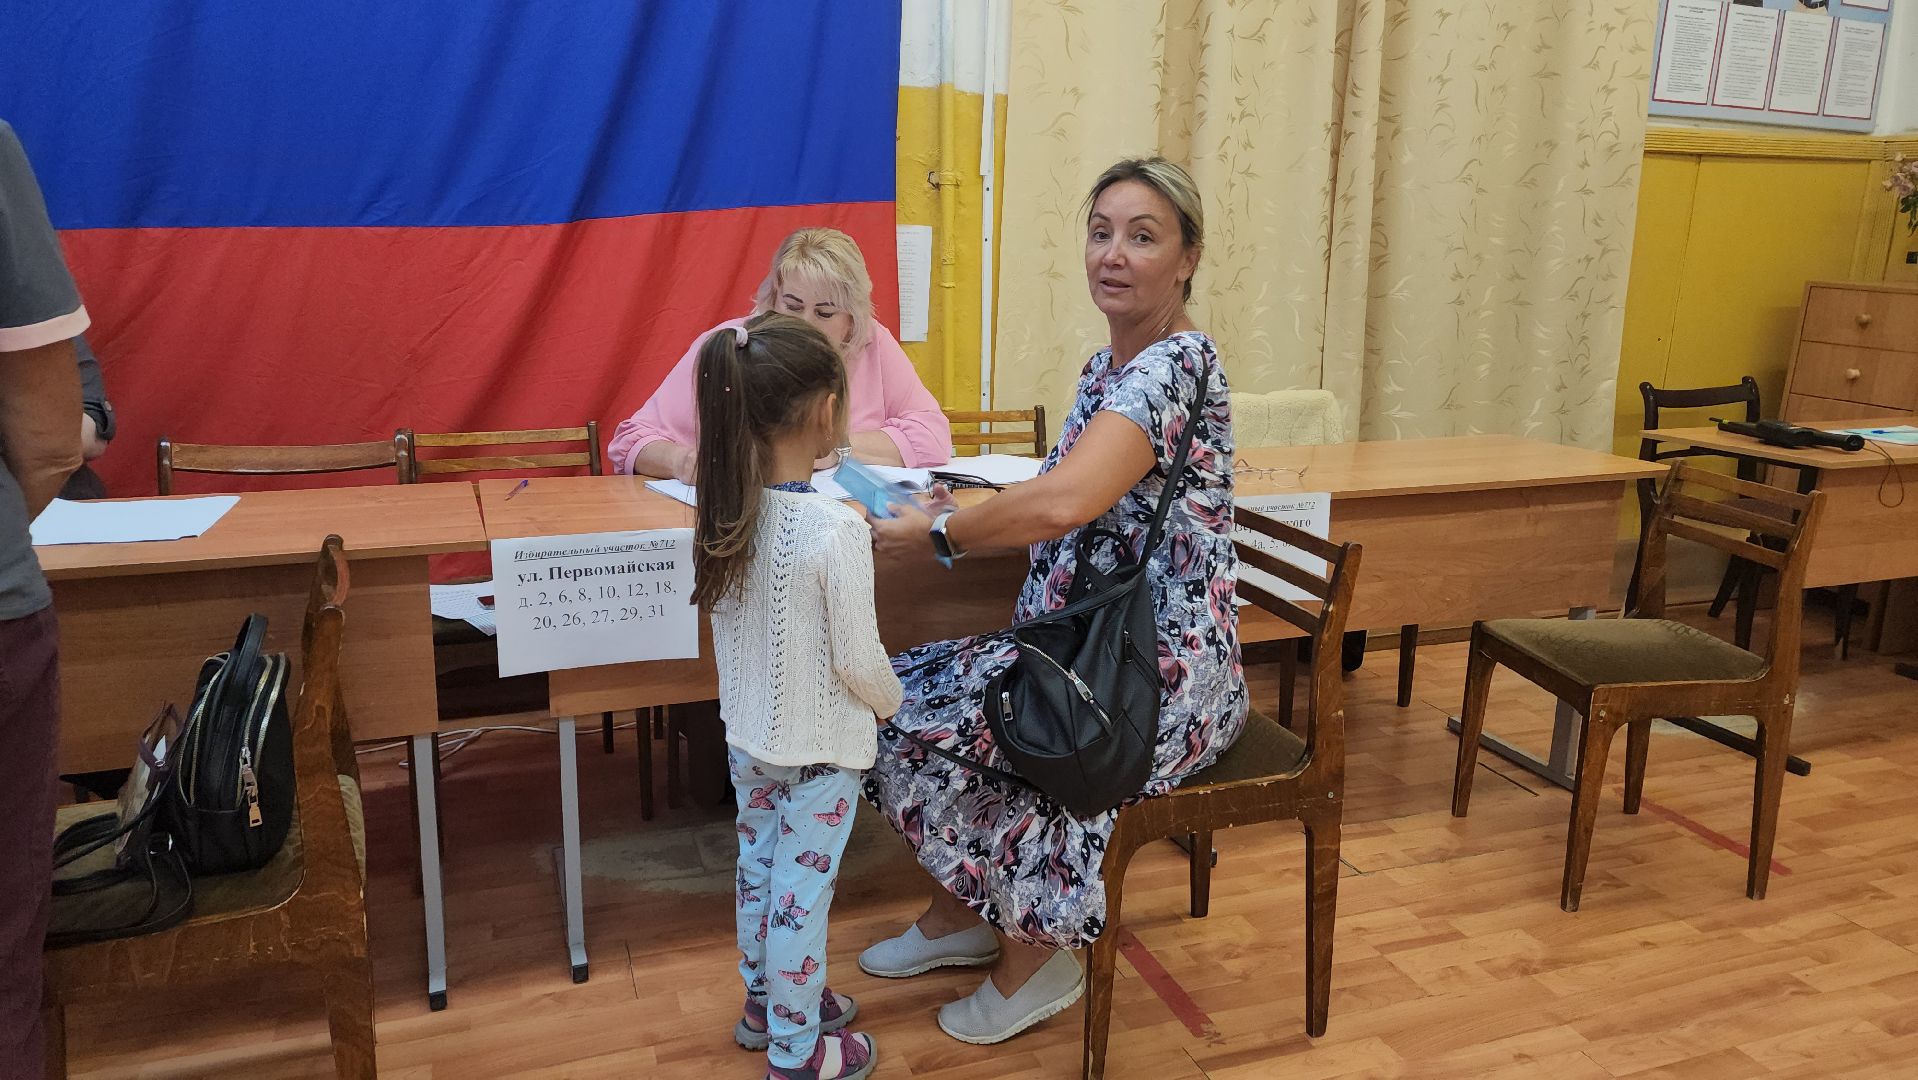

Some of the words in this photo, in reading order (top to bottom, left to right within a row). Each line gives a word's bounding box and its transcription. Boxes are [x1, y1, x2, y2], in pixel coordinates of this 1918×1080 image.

[514, 545, 601, 561] Избирательный
[603, 543, 645, 554] участок
[647, 539, 676, 550] №712
[517, 572, 543, 587] ул.
[549, 560, 675, 582] Первомайская
[518, 597, 533, 609] д.
[537, 591, 553, 607] 2,
[558, 589, 573, 605] 6,
[578, 587, 592, 602] 8,
[599, 585, 621, 600] 10,
[627, 582, 649, 598] 12,
[655, 580, 677, 596] 18,
[532, 615, 557, 631] 20,
[561, 611, 586, 627] 26,
[591, 609, 615, 624] 27,
[620, 606, 643, 622] 29,
[647, 603, 665, 618] 31
